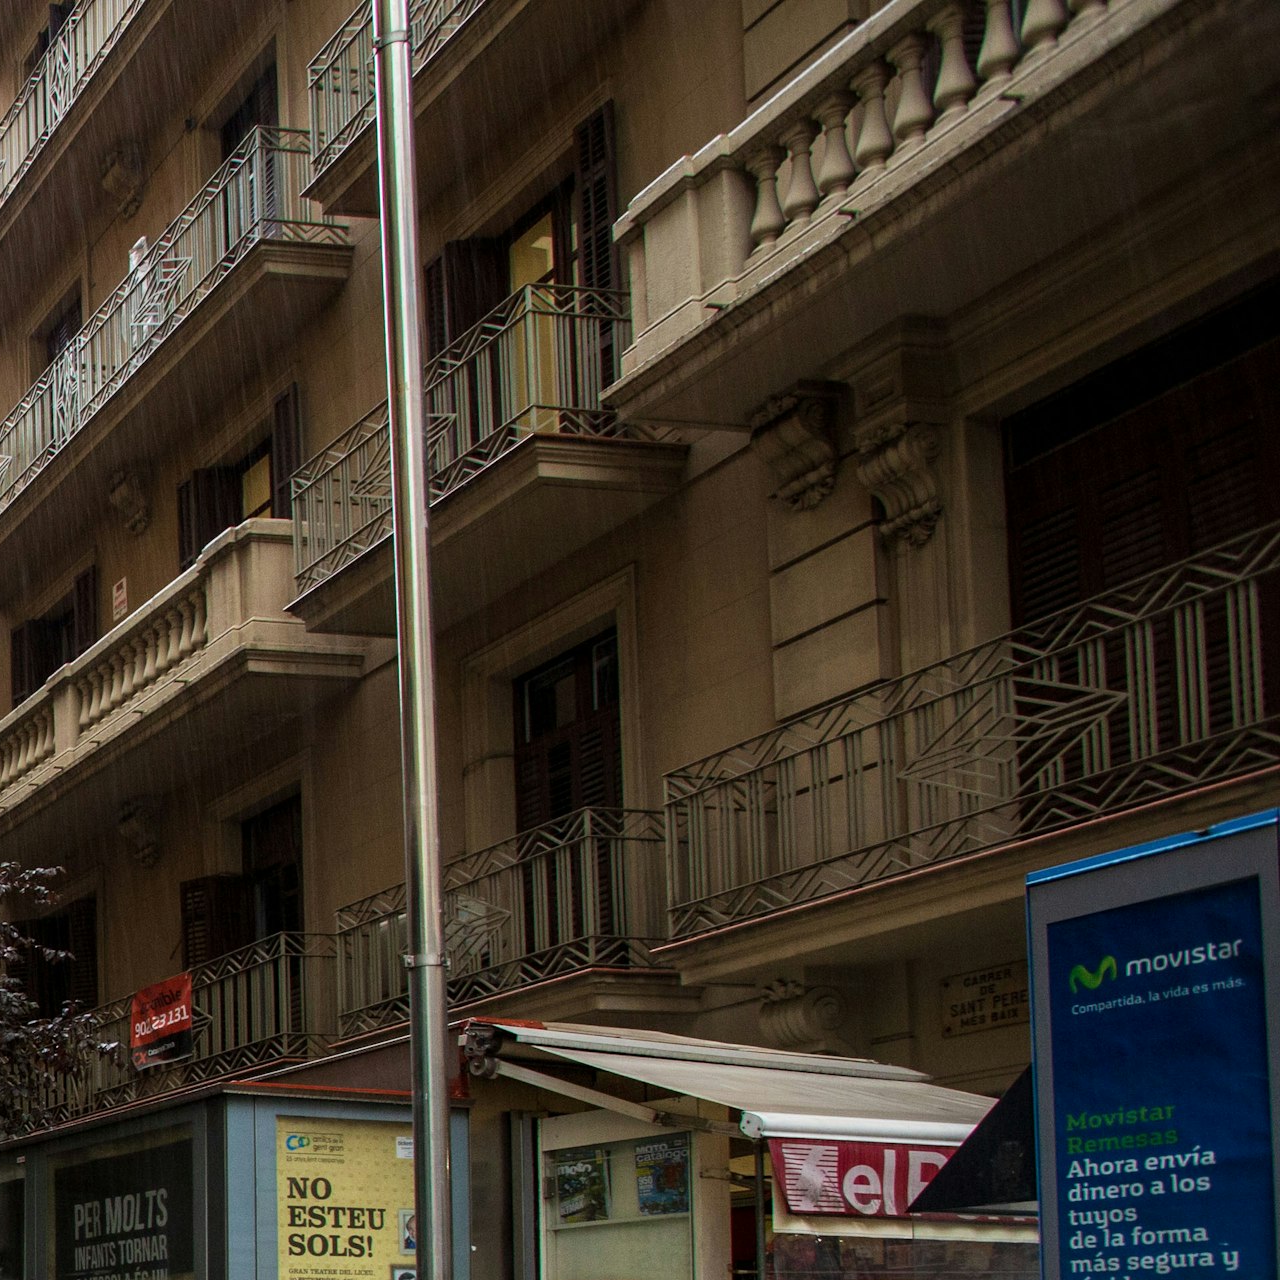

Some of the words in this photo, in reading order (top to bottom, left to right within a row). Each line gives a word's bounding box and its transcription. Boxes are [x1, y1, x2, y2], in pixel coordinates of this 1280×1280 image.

[1125, 938, 1244, 977] movistar
[950, 998, 986, 1018] SANT
[992, 988, 1029, 1009] PERE
[980, 983, 996, 996] DE
[1071, 991, 1146, 1016] Compartida,
[1148, 990, 1161, 1003] la
[1163, 984, 1190, 1000] vida
[1192, 981, 1210, 995] es
[991, 1007, 1019, 1022] BAIX
[1066, 1104, 1176, 1132] Movistar
[1067, 1128, 1180, 1155] Remesas
[1066, 1157, 1139, 1179] Ahora
[1143, 1145, 1217, 1172] envía
[286, 1177, 332, 1200] NO
[1067, 1181, 1144, 1202] dinero
[1150, 1178, 1167, 1193] a
[1170, 1173, 1212, 1193] los
[73, 1200, 102, 1241] PER
[104, 1187, 169, 1236] MOLTS
[287, 1206, 386, 1230] ESTEU
[1068, 1207, 1139, 1228] tuyos
[287, 1234, 374, 1258] SOLS!
[1069, 1230, 1098, 1250] de
[1103, 1228, 1126, 1249] la
[1131, 1224, 1210, 1247] forma
[74, 1241, 117, 1272] INFANTS
[118, 1233, 168, 1266] TORNAR
[1070, 1250, 1122, 1273] más
[1126, 1249, 1216, 1275] segura
[1222, 1249, 1241, 1271] y
